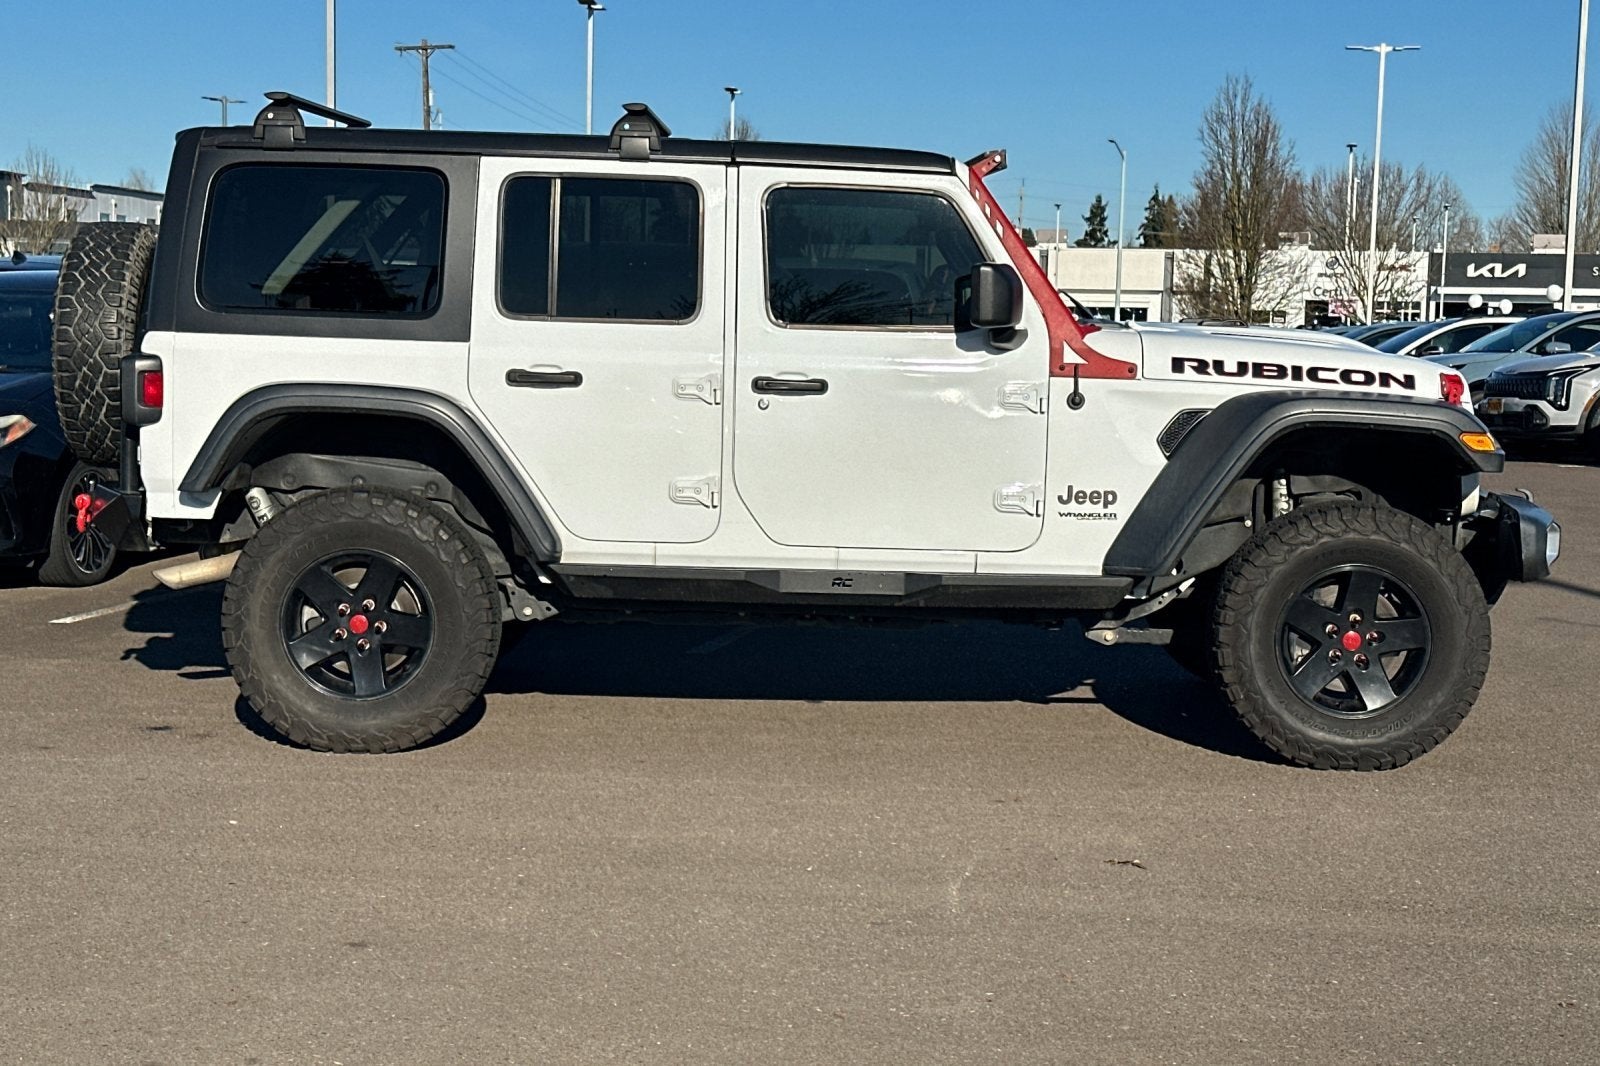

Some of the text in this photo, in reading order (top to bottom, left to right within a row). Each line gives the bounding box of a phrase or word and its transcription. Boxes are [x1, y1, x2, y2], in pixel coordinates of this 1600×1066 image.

[1466, 262, 1527, 278] KIA
[1171, 356, 1416, 390] RUBICON
[1057, 484, 1118, 509] Jeep
